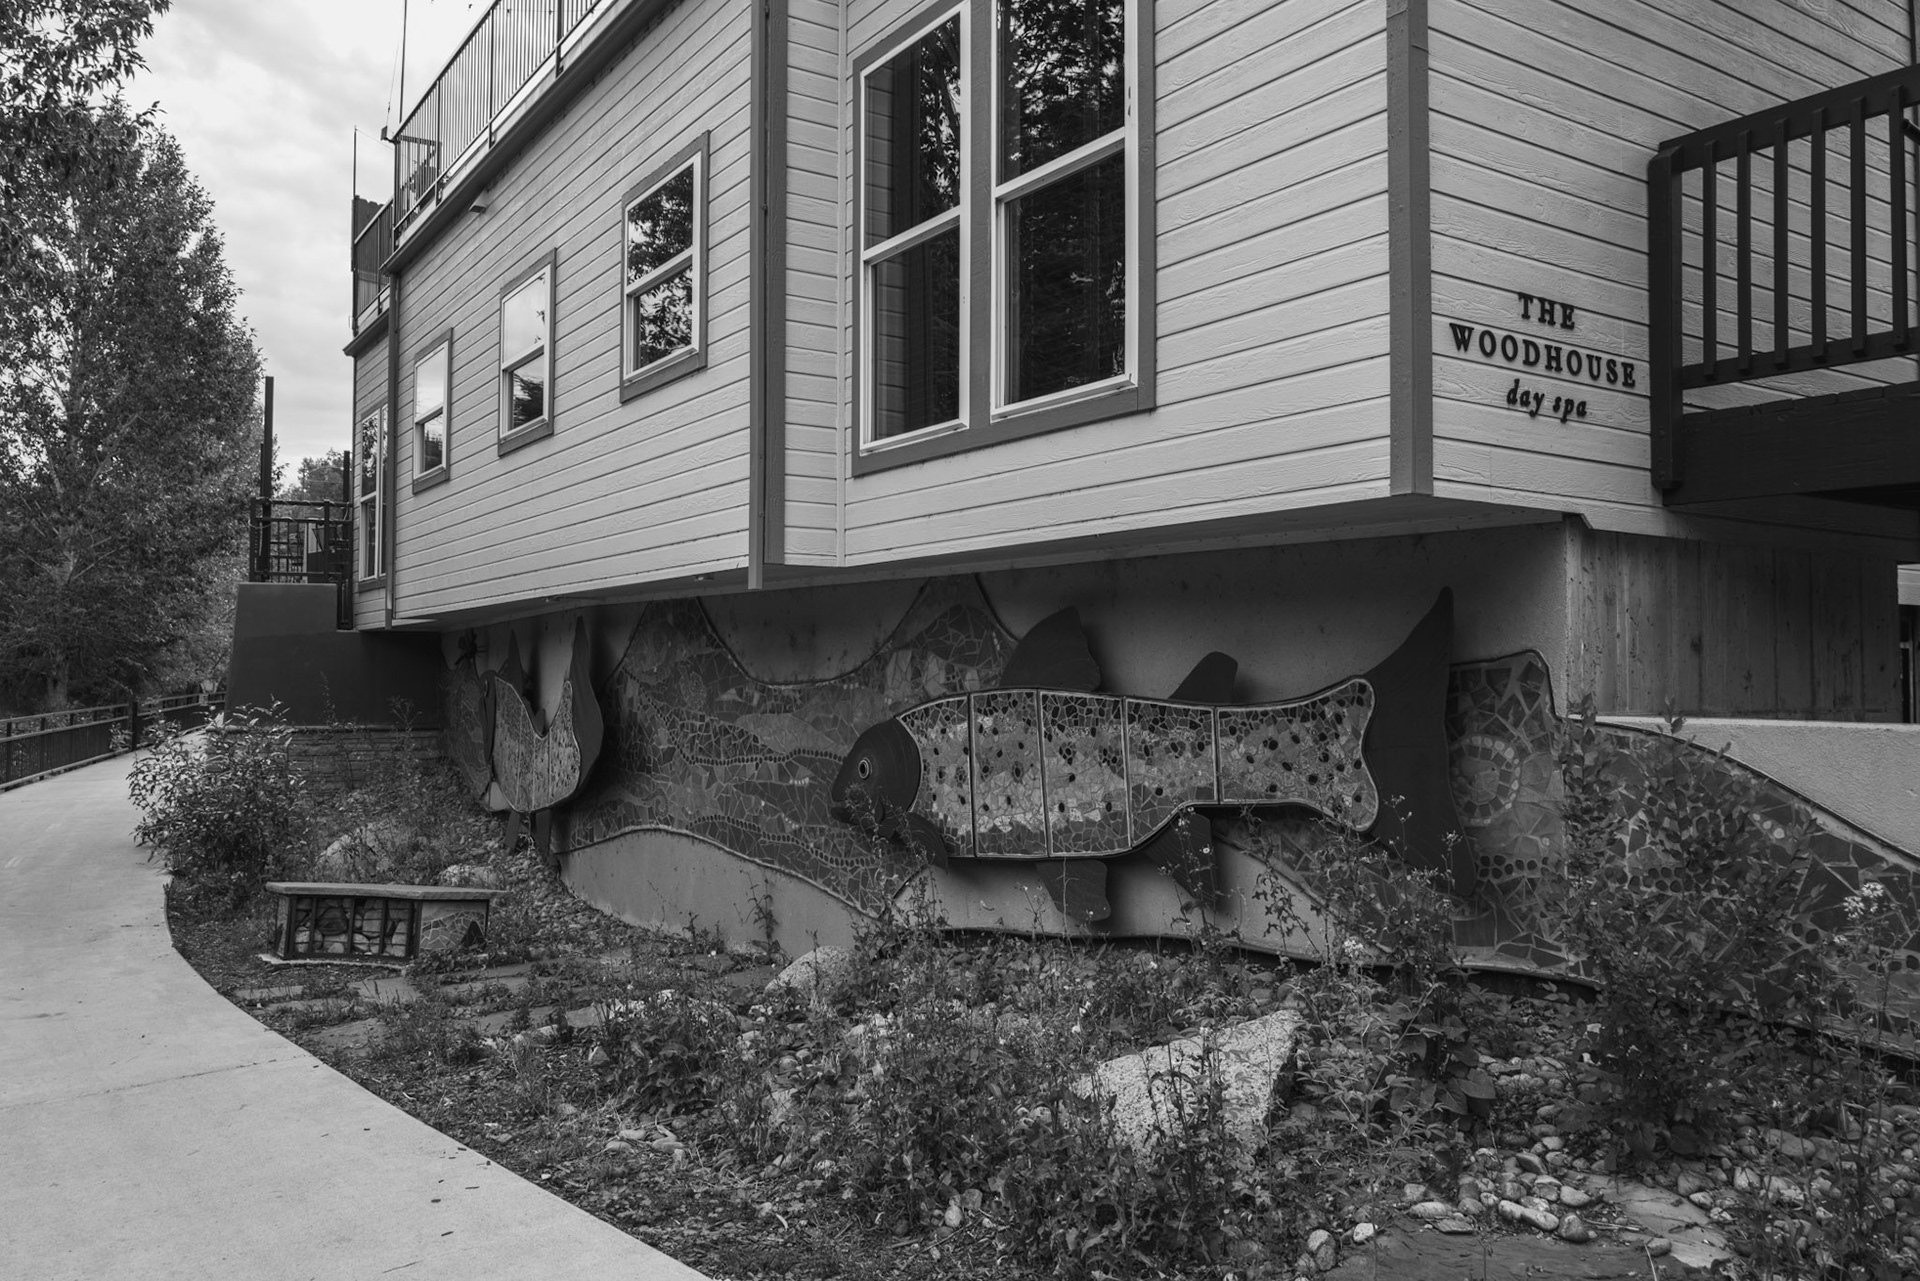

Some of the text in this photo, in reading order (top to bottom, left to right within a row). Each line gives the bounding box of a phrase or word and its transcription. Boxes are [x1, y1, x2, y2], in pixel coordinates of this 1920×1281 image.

[1518, 292, 1575, 330] THE
[1449, 323, 1636, 388] WOODHOUSE
[1506, 378, 1588, 424] day spa
